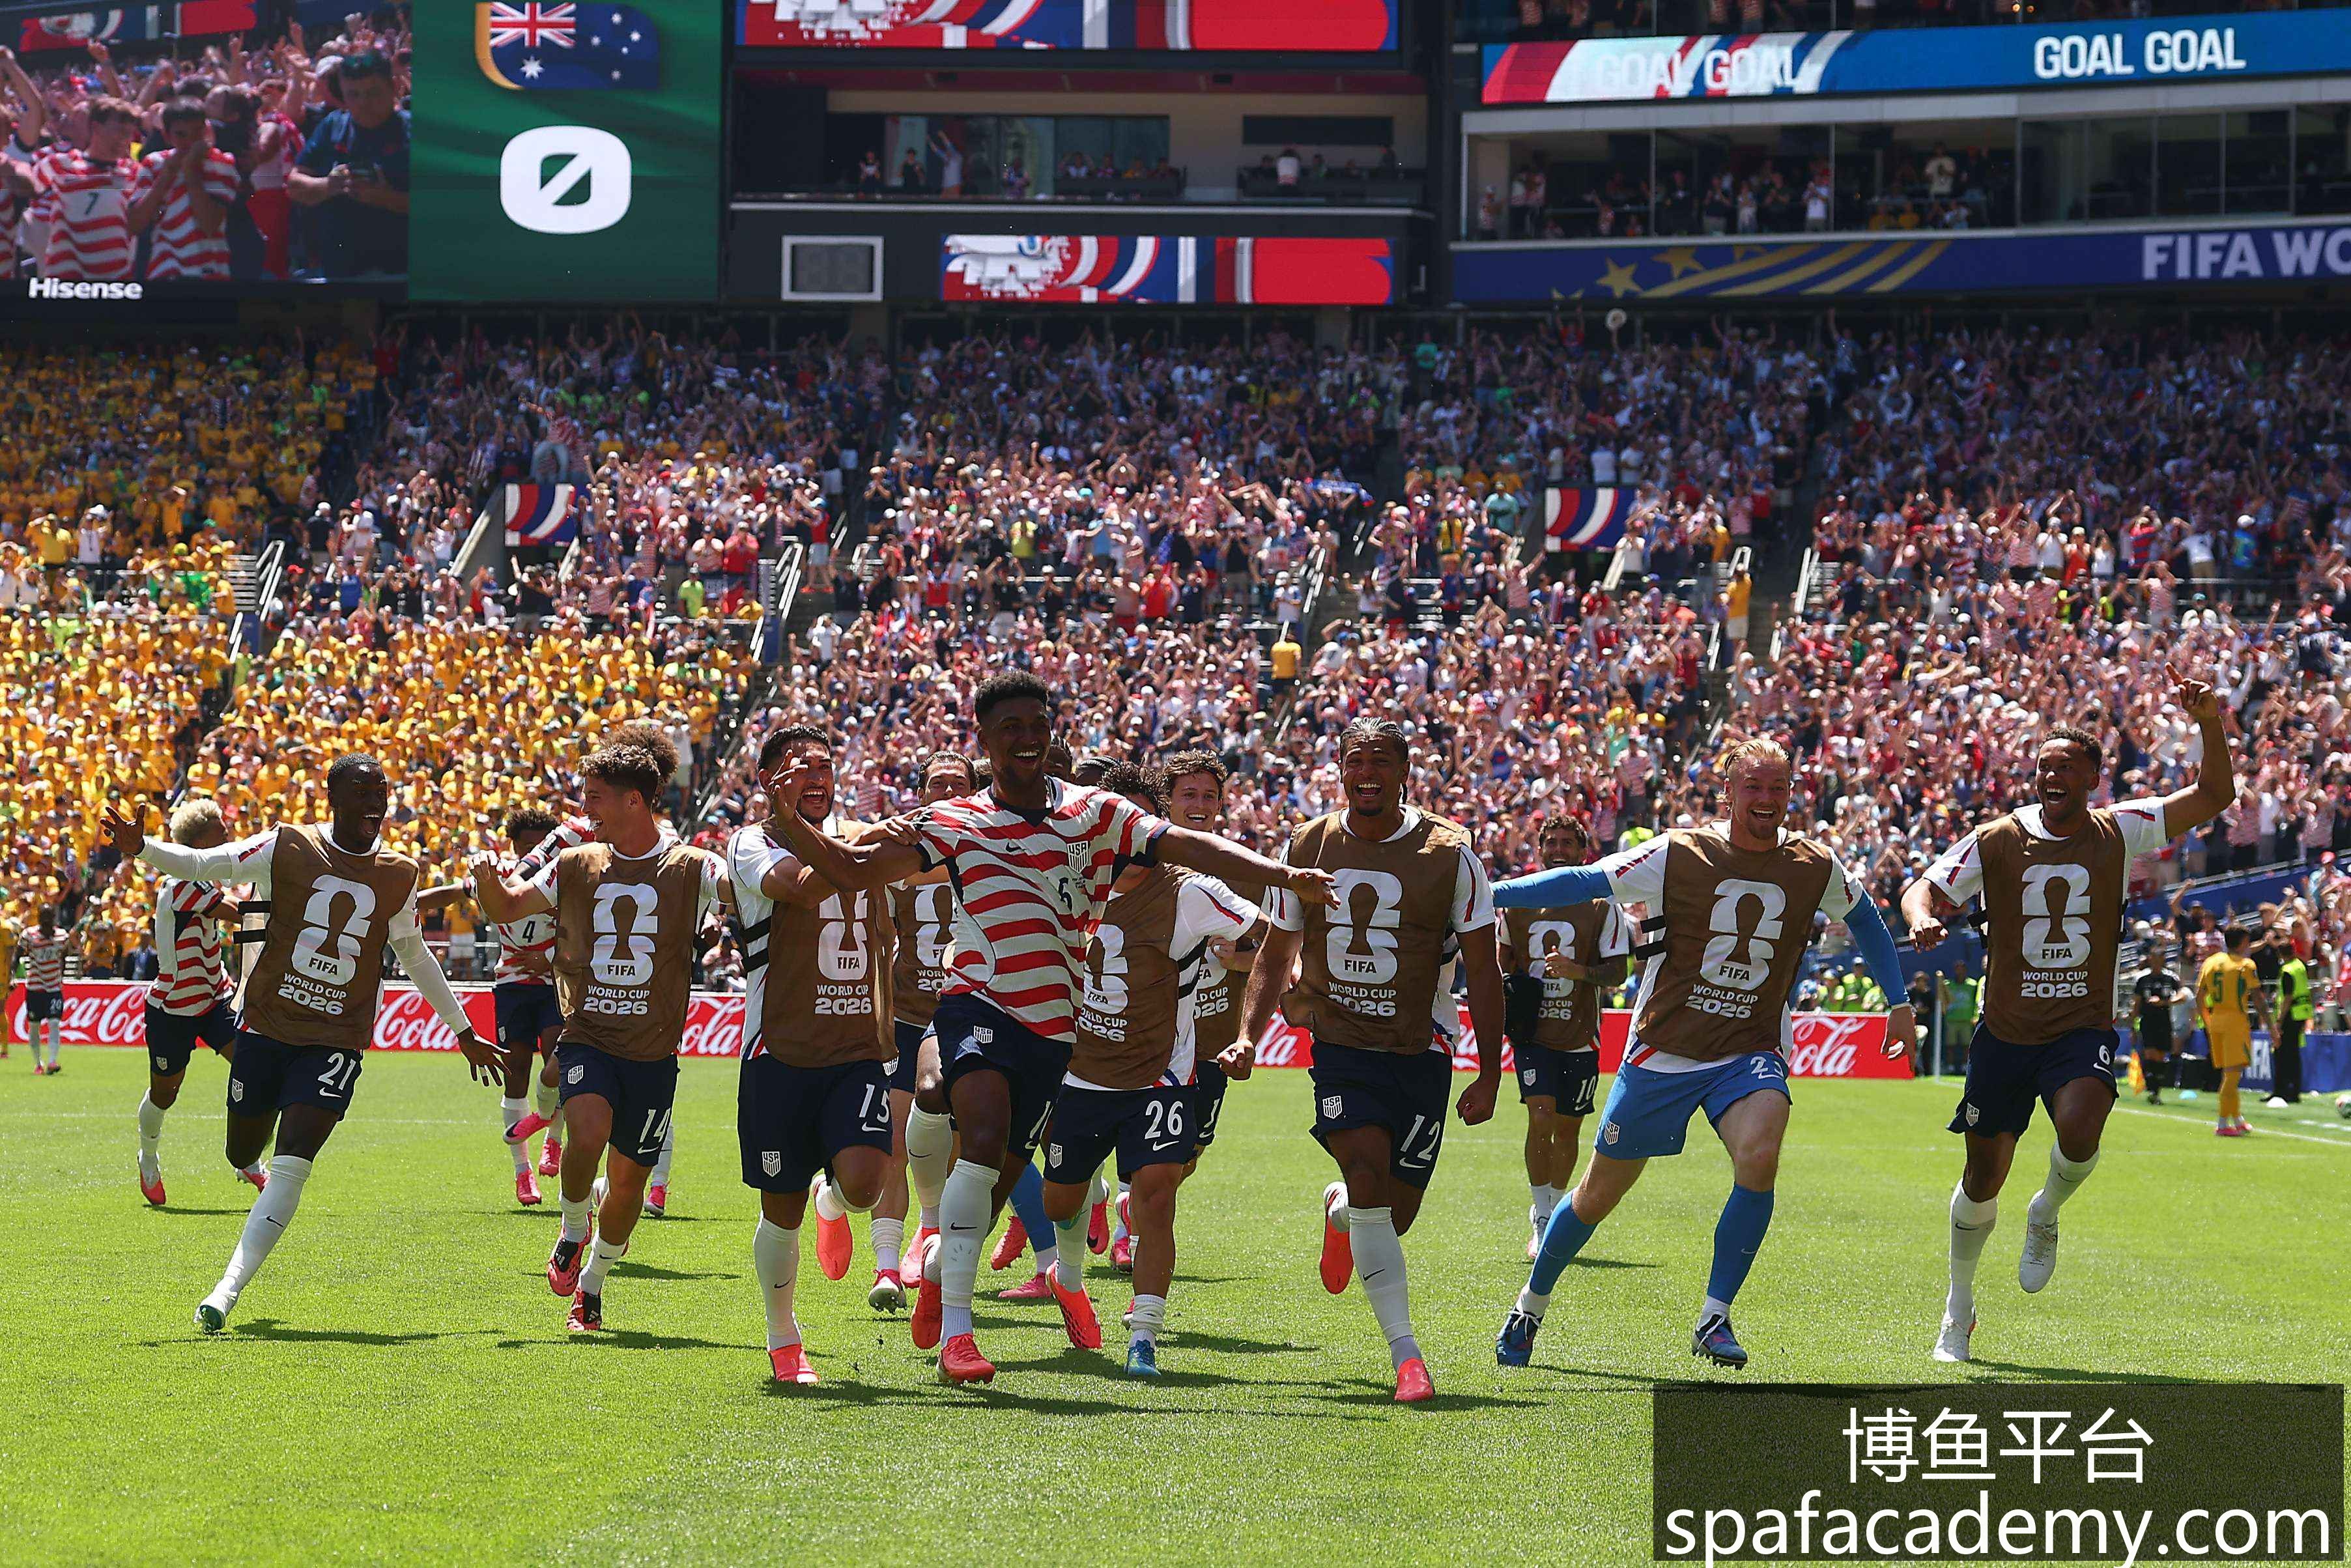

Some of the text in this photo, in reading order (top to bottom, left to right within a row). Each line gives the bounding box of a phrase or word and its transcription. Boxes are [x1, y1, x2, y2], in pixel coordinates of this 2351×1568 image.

[2034, 27, 2247, 79] GOAL GOAL
[1703, 45, 1802, 90] GOAL
[500, 126, 632, 235] 0
[2143, 233, 2264, 281] FIFA
[28, 277, 143, 300] Hisense
[521, 920, 536, 943] 4
[838, 956, 860, 970] FIFA
[2042, 948, 2073, 960] FIFA
[309, 958, 339, 975] FIFA
[607, 964, 636, 976] FIFA
[1344, 959, 1377, 974] FIFA
[1718, 965, 1750, 982] FIFA
[2022, 971, 2088, 982] WORLD CUP
[283, 972, 348, 1001] WORLD CUP
[588, 985, 650, 999] WORLD CUP
[817, 984, 870, 997] WORLD CUP
[1209, 986, 1229, 999] CUP
[1328, 981, 1397, 999] WORLD CUP
[1692, 984, 1758, 1004] WORLD CUP
[2021, 982, 2089, 999] 2026
[278, 984, 344, 1016] 2026
[583, 997, 649, 1015] 2026
[814, 997, 872, 1016] 2026
[1684, 995, 1752, 1019] 2026
[1081, 1007, 1128, 1028] ORLD CUP
[1538, 1008, 1572, 1020] 026
[1077, 1016, 1126, 1042] 026
[2099, 1045, 2111, 1066] 6
[318, 1052, 357, 1091] 21
[1576, 1076, 1597, 1104] 10
[859, 1083, 890, 1124] 15
[639, 1107, 672, 1143] 14
[1144, 1100, 1184, 1140] 26
[1400, 1114, 1440, 1162] 12
